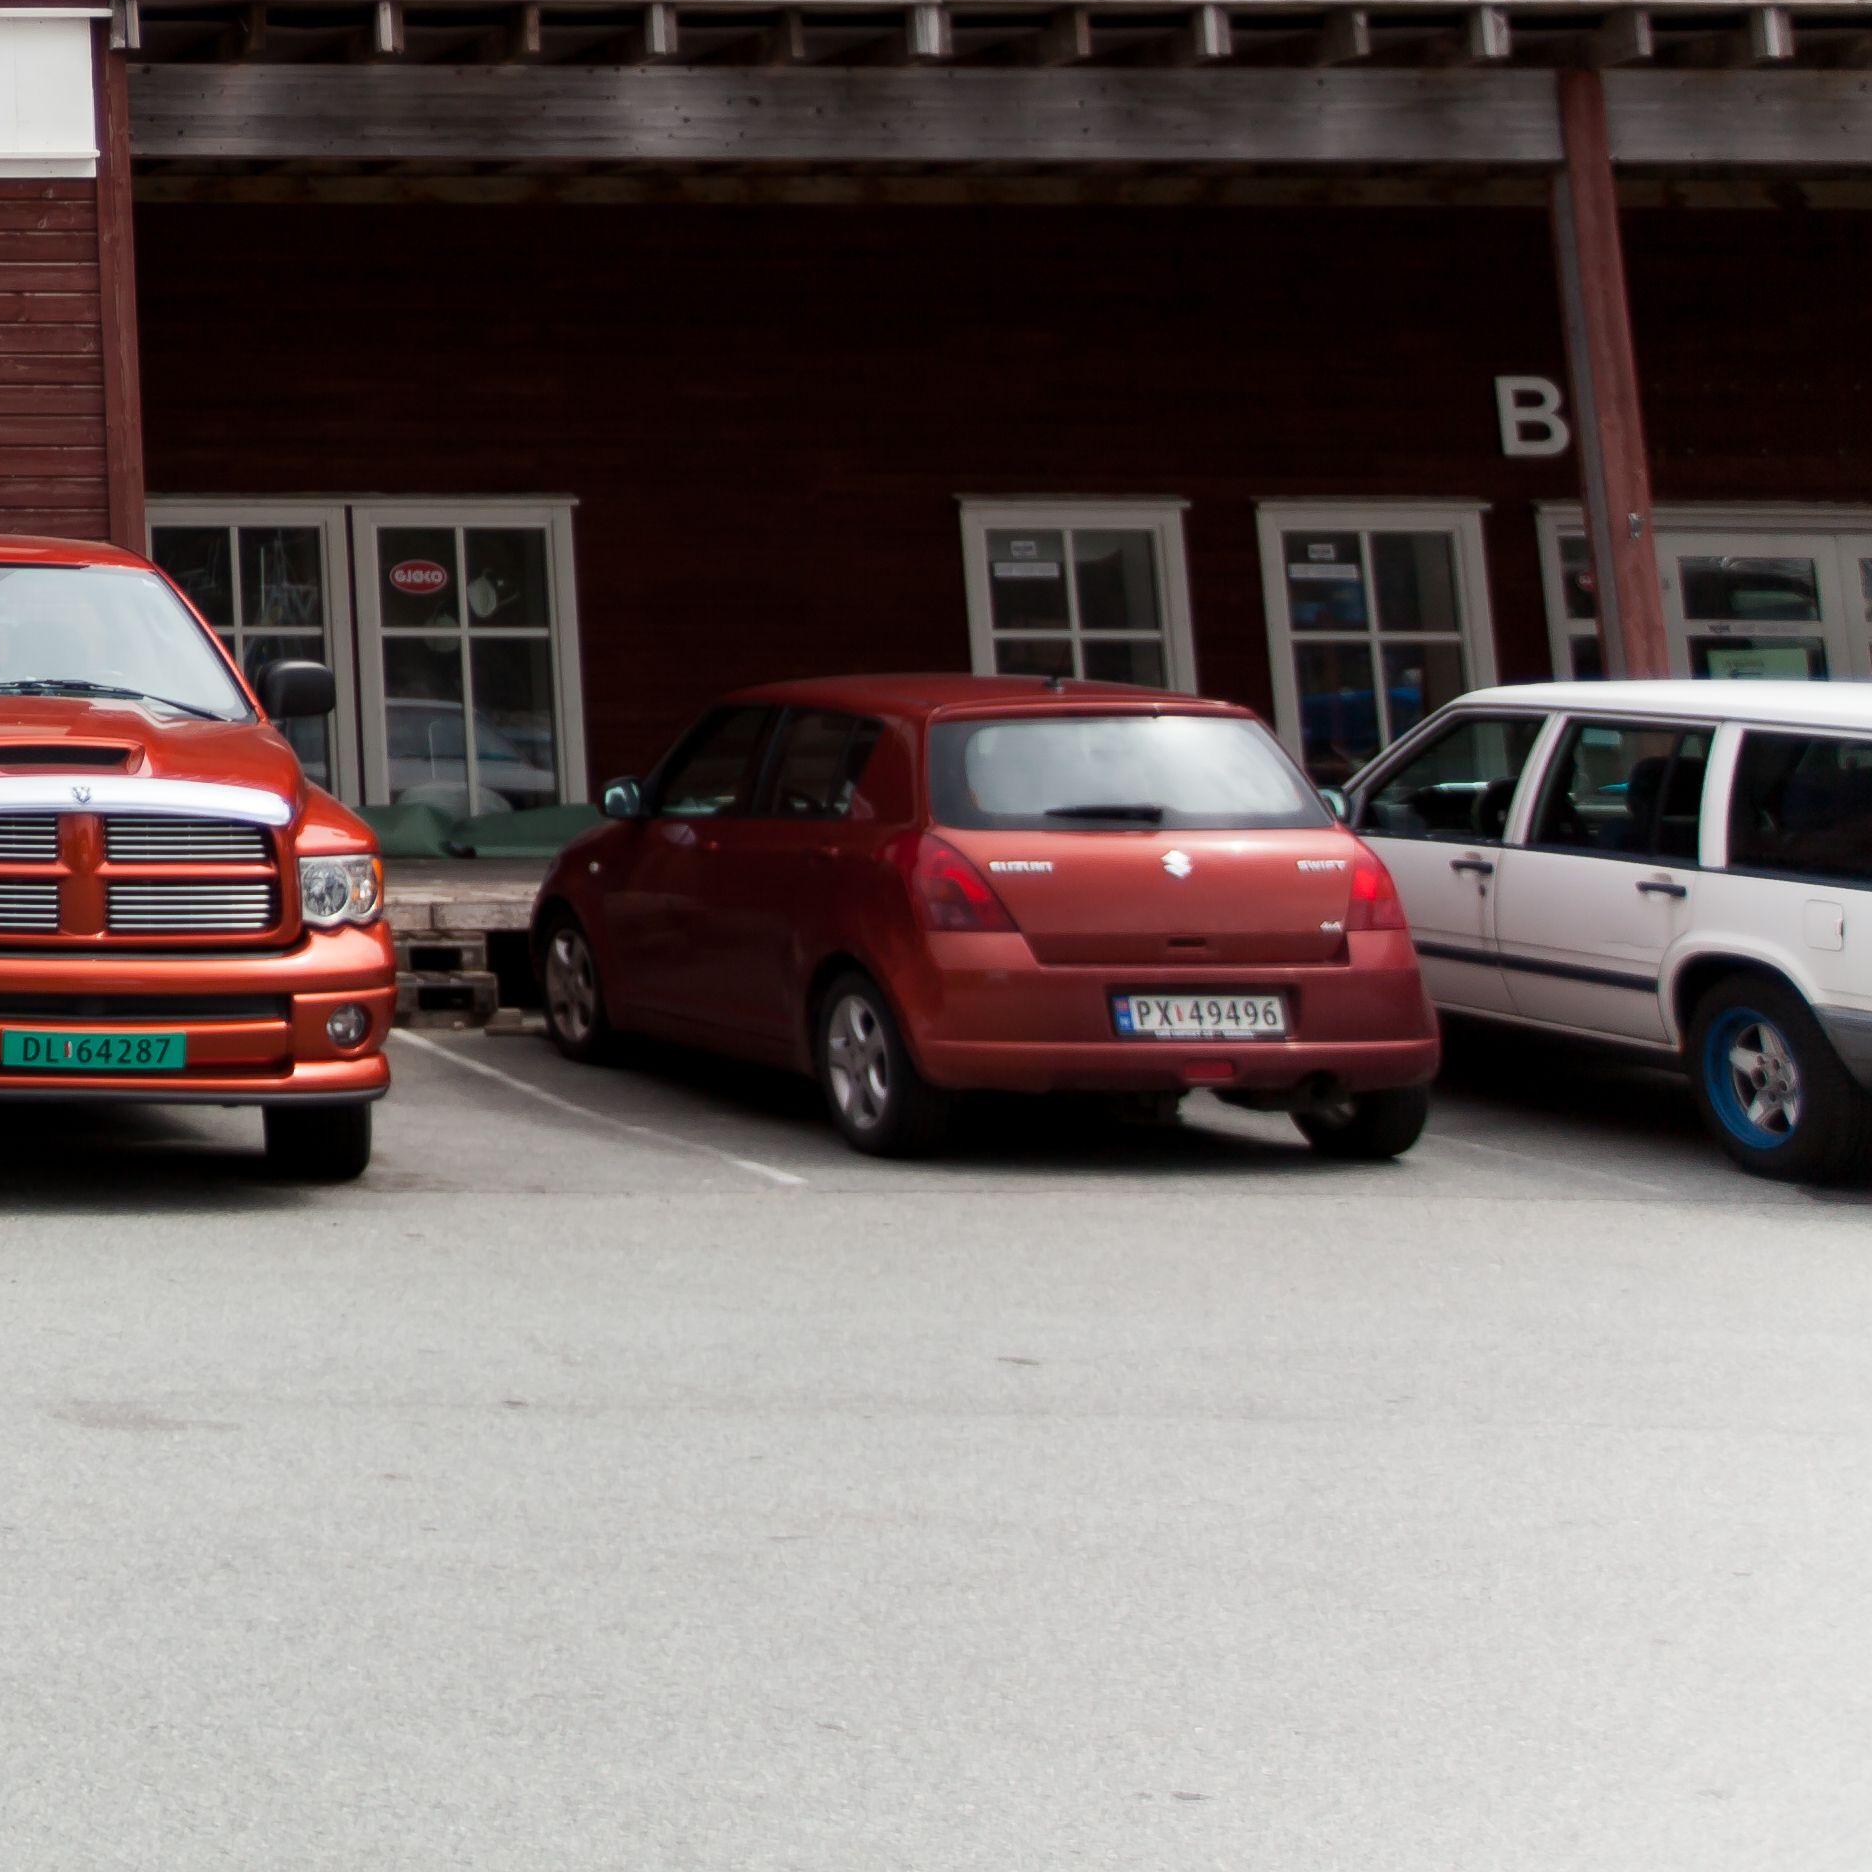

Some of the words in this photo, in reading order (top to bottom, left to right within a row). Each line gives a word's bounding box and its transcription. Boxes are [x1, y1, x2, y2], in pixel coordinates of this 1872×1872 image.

[1493, 375, 1570, 458] B
[1136, 1000, 1173, 1026] PX
[1189, 1000, 1278, 1026] 49496
[22, 1036, 59, 1063] DL
[76, 1038, 171, 1064] 64287
